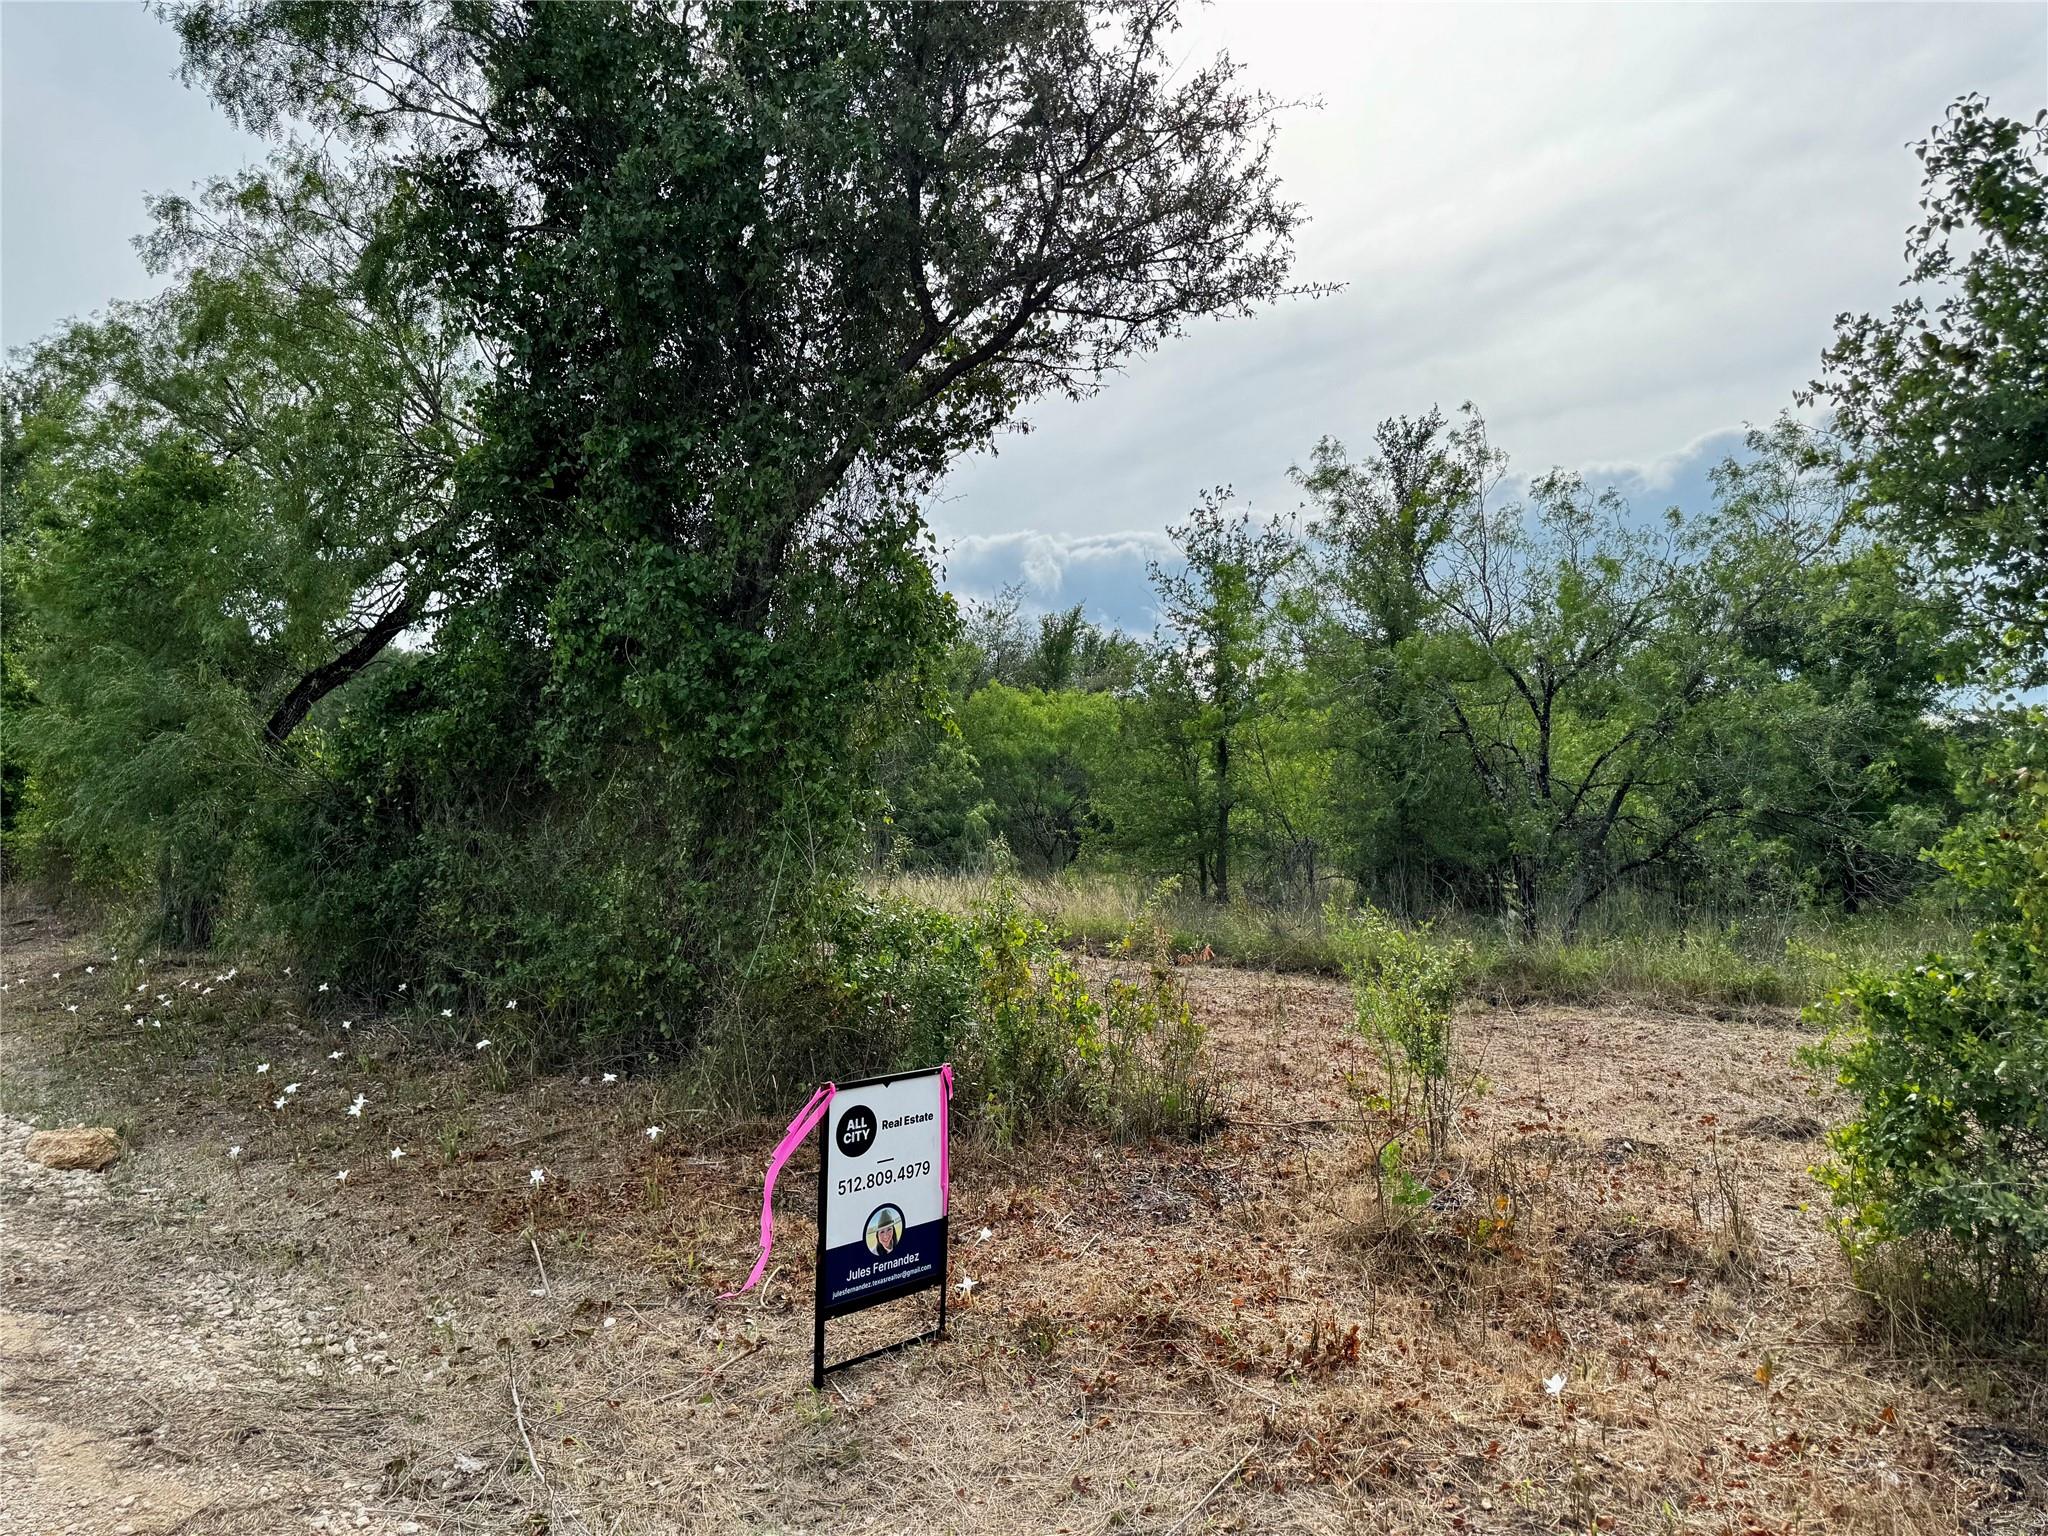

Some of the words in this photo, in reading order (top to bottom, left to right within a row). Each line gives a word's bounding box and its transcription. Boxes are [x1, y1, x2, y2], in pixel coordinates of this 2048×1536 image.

[847, 1117, 868, 1131] ALL
[882, 1117, 902, 1130] Real
[904, 1112, 934, 1126] Estate
[843, 1128, 870, 1144] CITY
[838, 1160, 930, 1196] 512.809.4979
[846, 1267, 871, 1282] Jules
[873, 1252, 920, 1274] Fernandez
